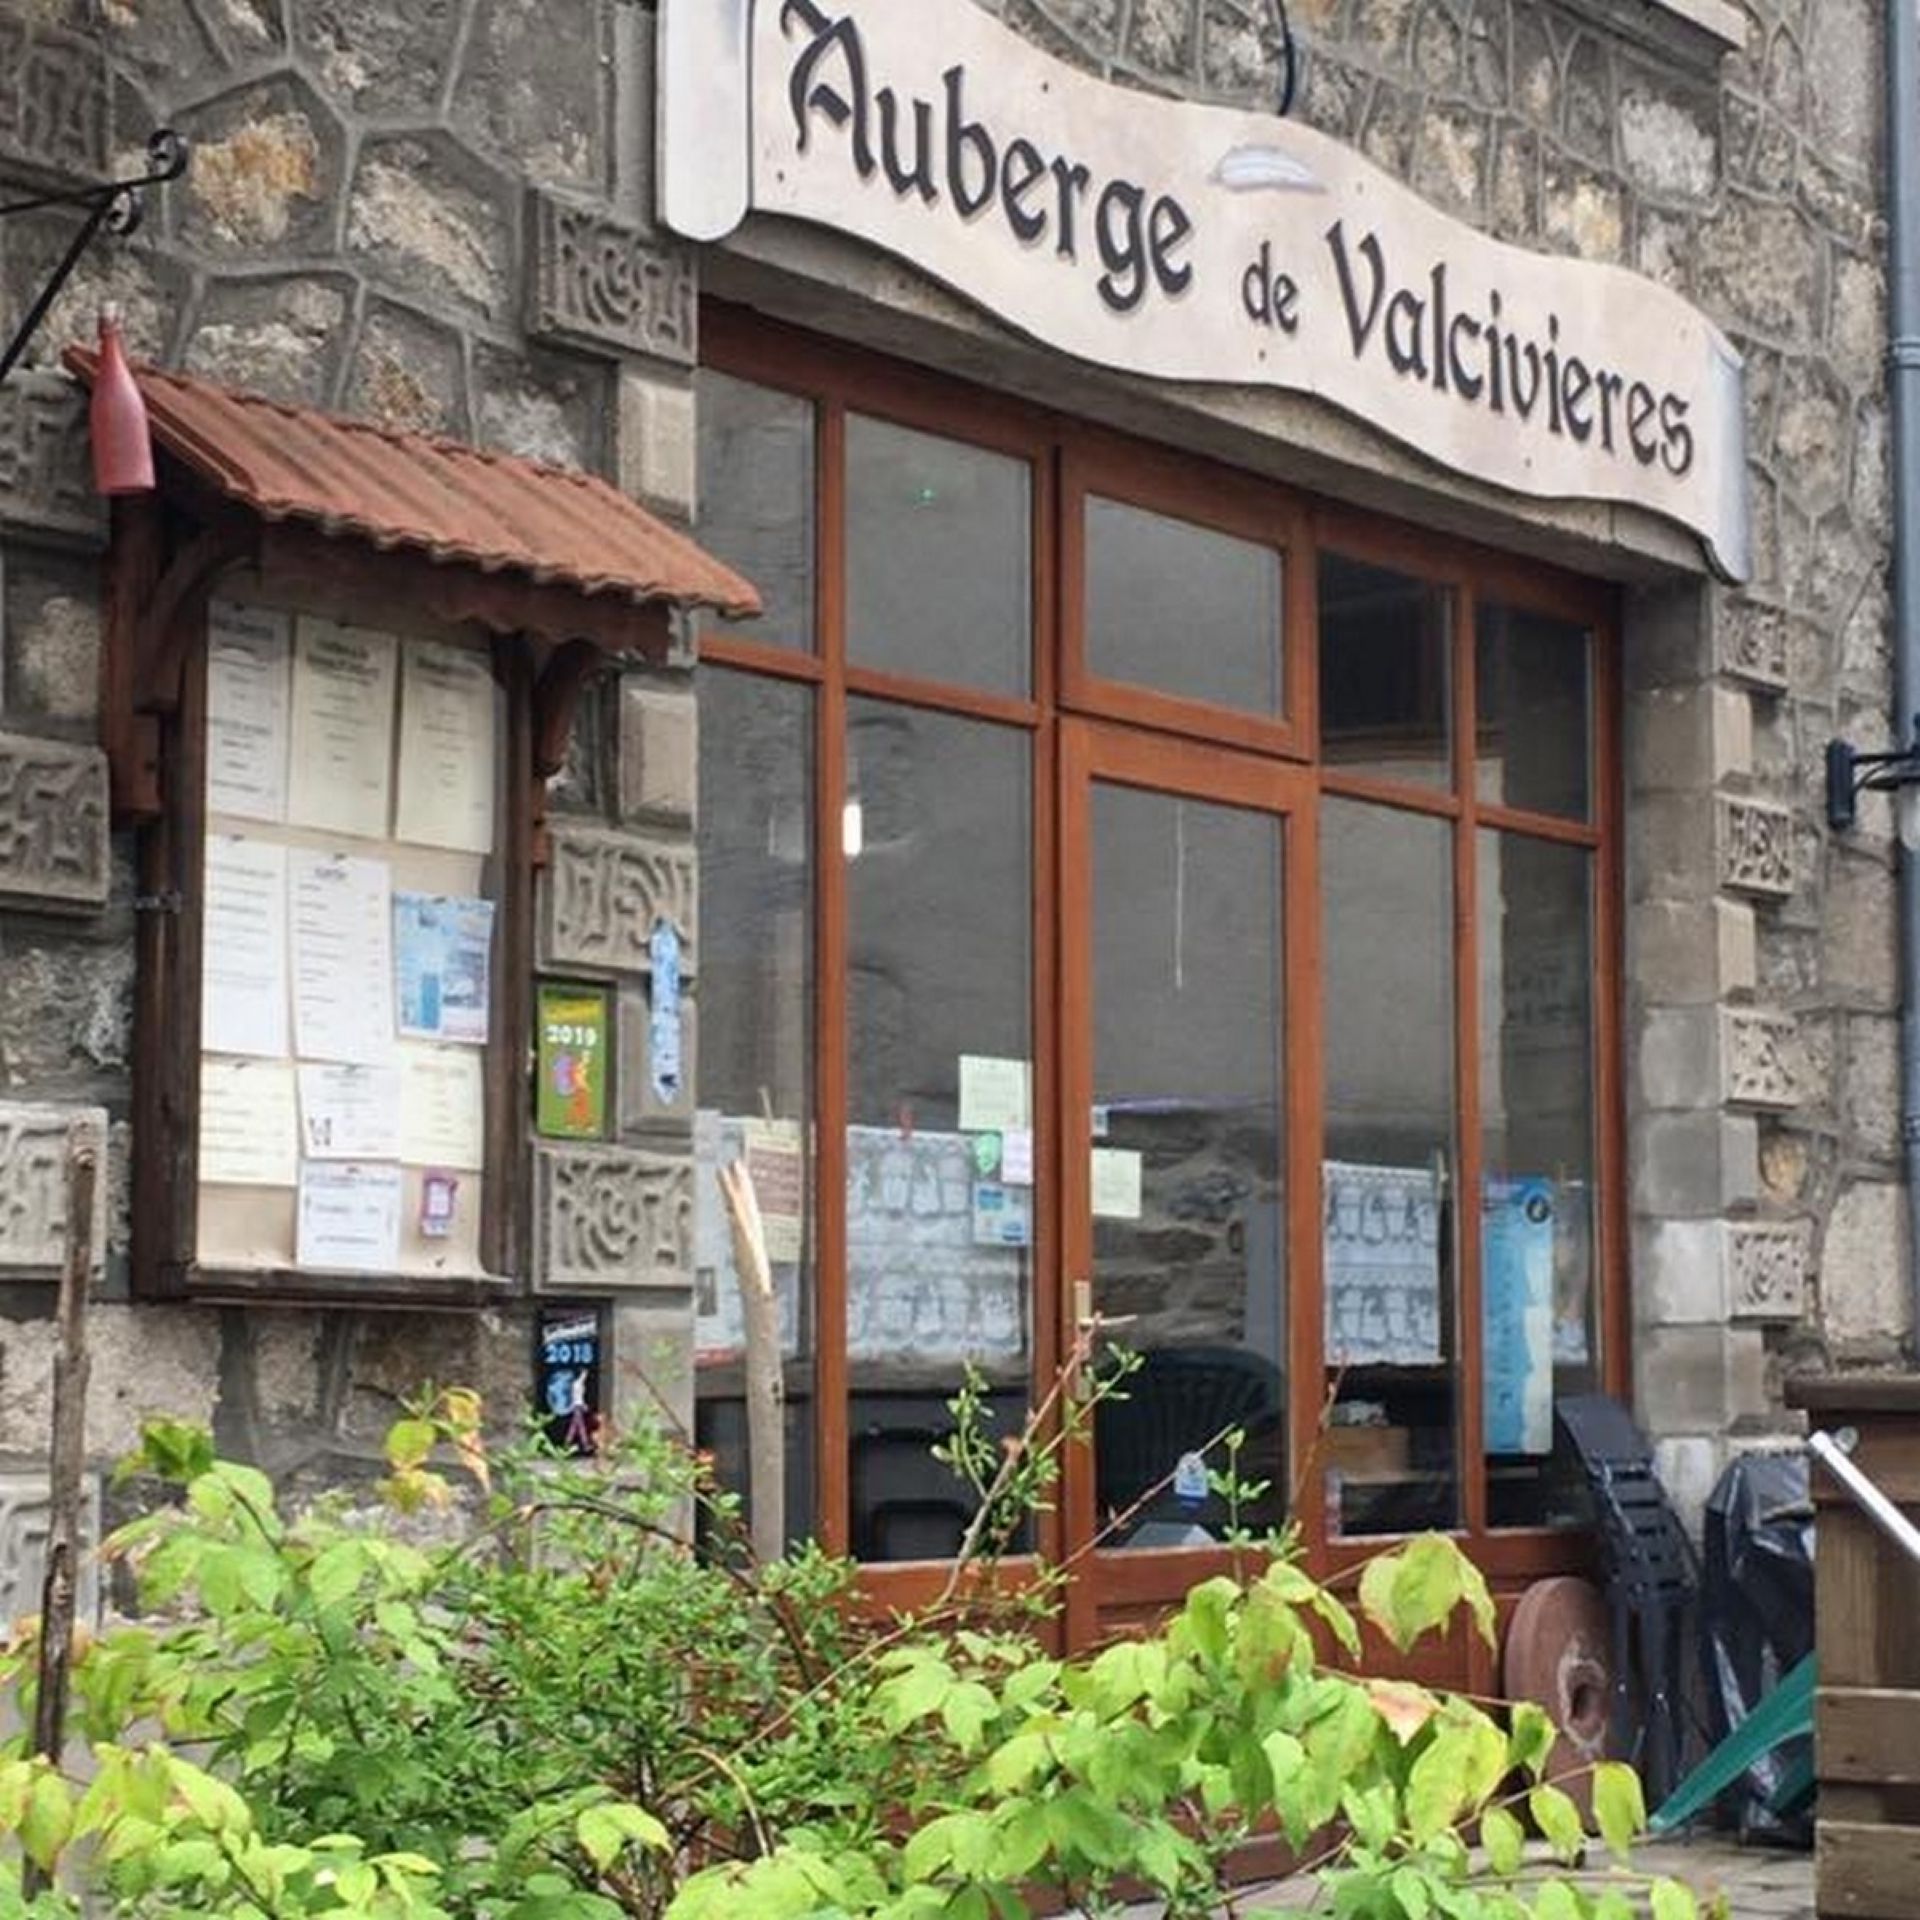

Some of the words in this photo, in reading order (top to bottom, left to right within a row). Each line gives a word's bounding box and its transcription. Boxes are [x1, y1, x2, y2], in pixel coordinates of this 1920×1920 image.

[779, 0, 1194, 313] Auberge
[1241, 239, 1298, 334] de
[1325, 218, 1695, 477] Valcivieres
[545, 1024, 597, 1047] 2019
[544, 1343, 593, 1364] 2018
